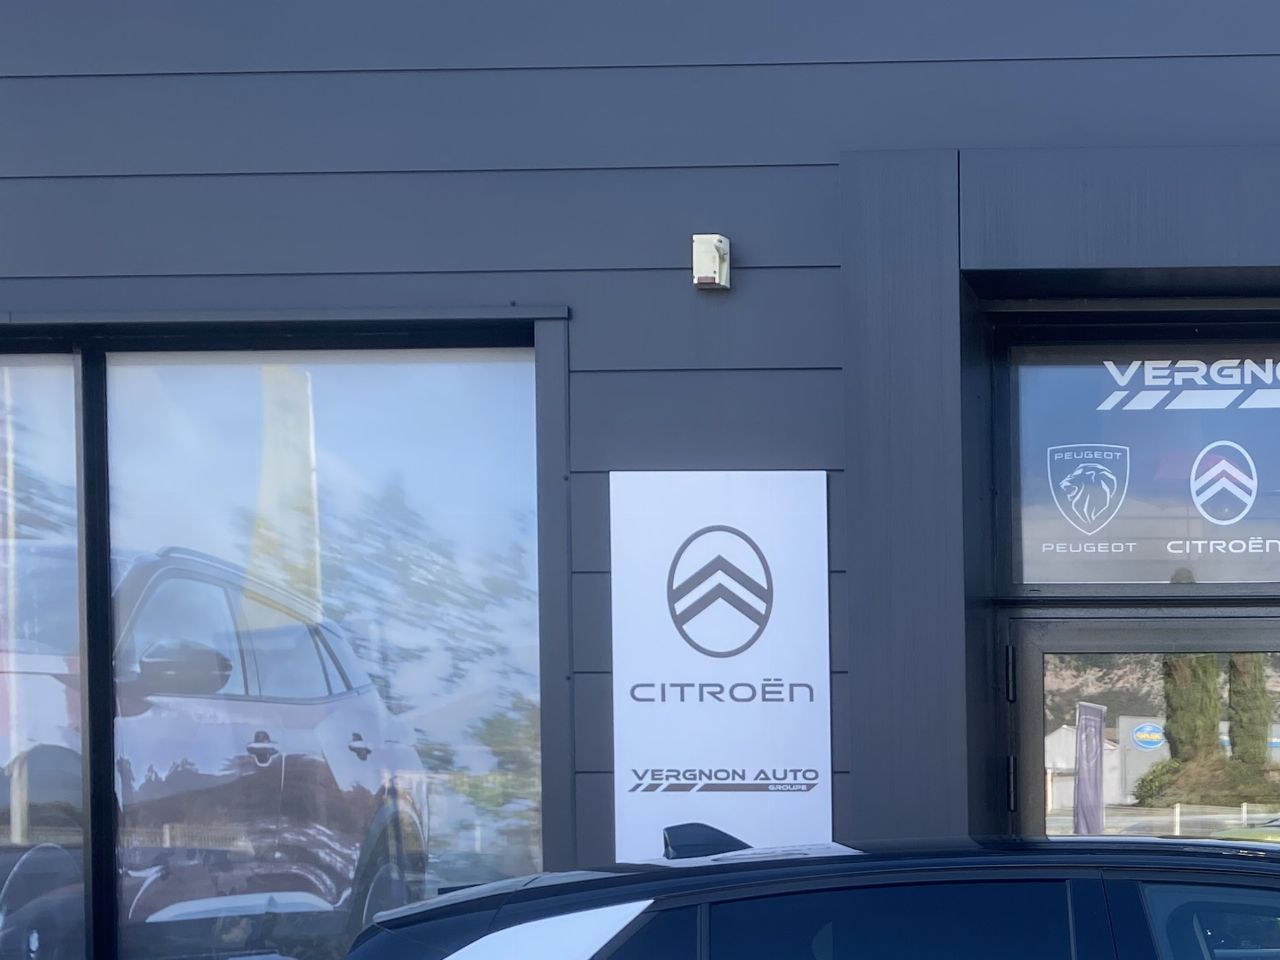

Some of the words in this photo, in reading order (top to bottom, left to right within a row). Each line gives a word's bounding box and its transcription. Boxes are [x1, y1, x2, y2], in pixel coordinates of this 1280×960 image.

[1054, 450, 1122, 461] PEUGEOT
[1041, 542, 1137, 553] PEUGEOT
[631, 768, 746, 781] VERGNON
[753, 768, 819, 781] AUTO
